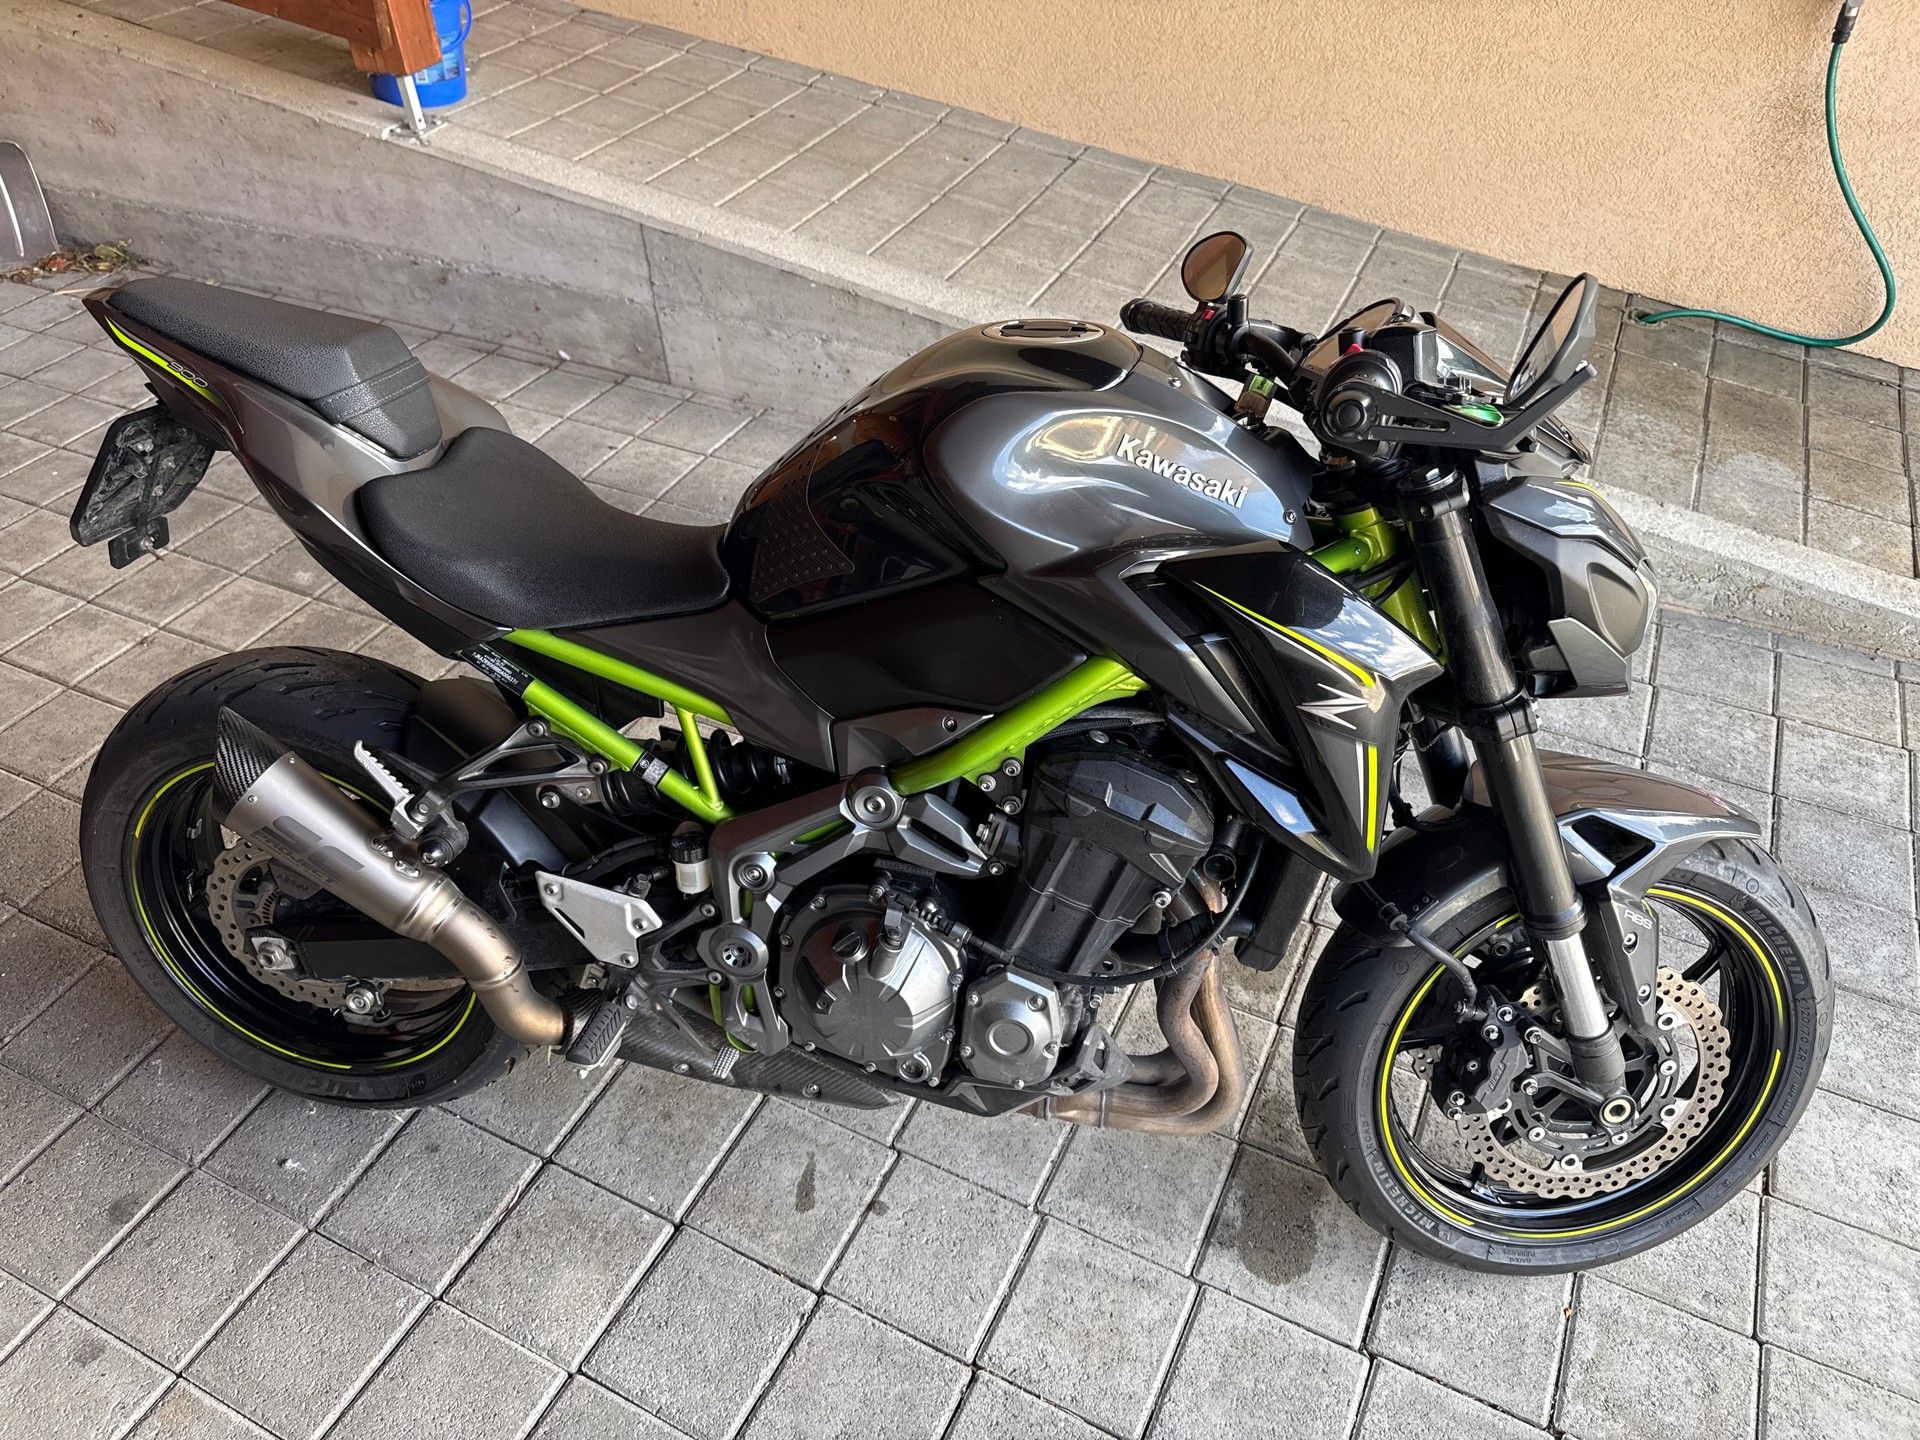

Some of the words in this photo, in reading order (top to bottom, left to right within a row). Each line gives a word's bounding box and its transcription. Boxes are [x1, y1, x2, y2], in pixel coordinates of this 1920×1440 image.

[169, 361, 208, 388] 900
[1116, 433, 1248, 509] Kawasaki
[252, 830, 338, 884] PROJECT
[1624, 909, 1652, 930] ABS
[1746, 907, 1805, 988] MICHELIN
[1799, 1003, 1810, 1044] 120/70
[1791, 1065, 1804, 1077] 17
[1795, 1046, 1809, 1062] ZR
[1361, 1120, 1374, 1150] ROAD
[1370, 1159, 1437, 1231] MICHELIN
